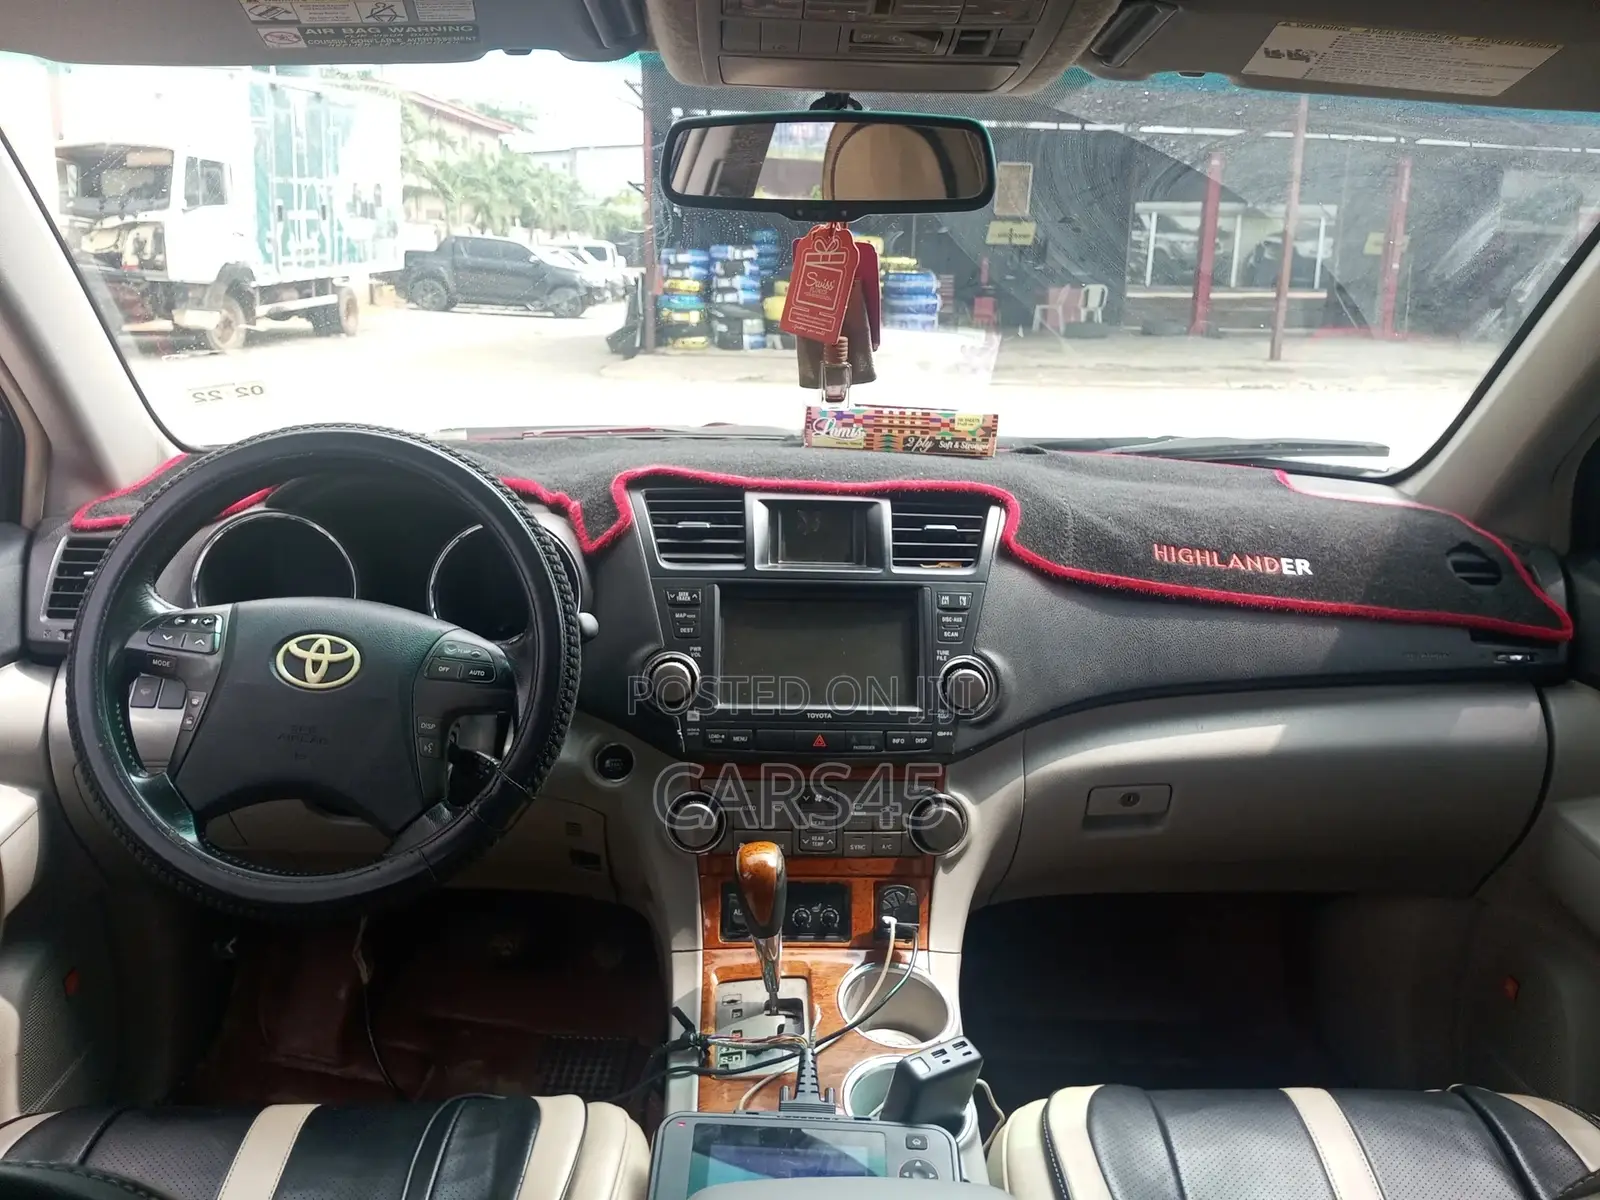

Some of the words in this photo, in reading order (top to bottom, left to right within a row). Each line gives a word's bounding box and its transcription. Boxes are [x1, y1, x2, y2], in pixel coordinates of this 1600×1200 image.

[304, 27, 335, 35] AIR
[341, 26, 381, 34] BAG
[388, 25, 473, 33] WARNING
[905, 436, 915, 448] 2
[911, 434, 935, 453] ply
[938, 440, 953, 450] Soft
[1152, 543, 1314, 576] HIGHLANDER
[152, 659, 171, 668] MODE
[438, 665, 450, 673] OFF
[469, 669, 486, 677] AUTO
[806, 712, 833, 720] TOYOTA
[420, 722, 436, 730] DISP
